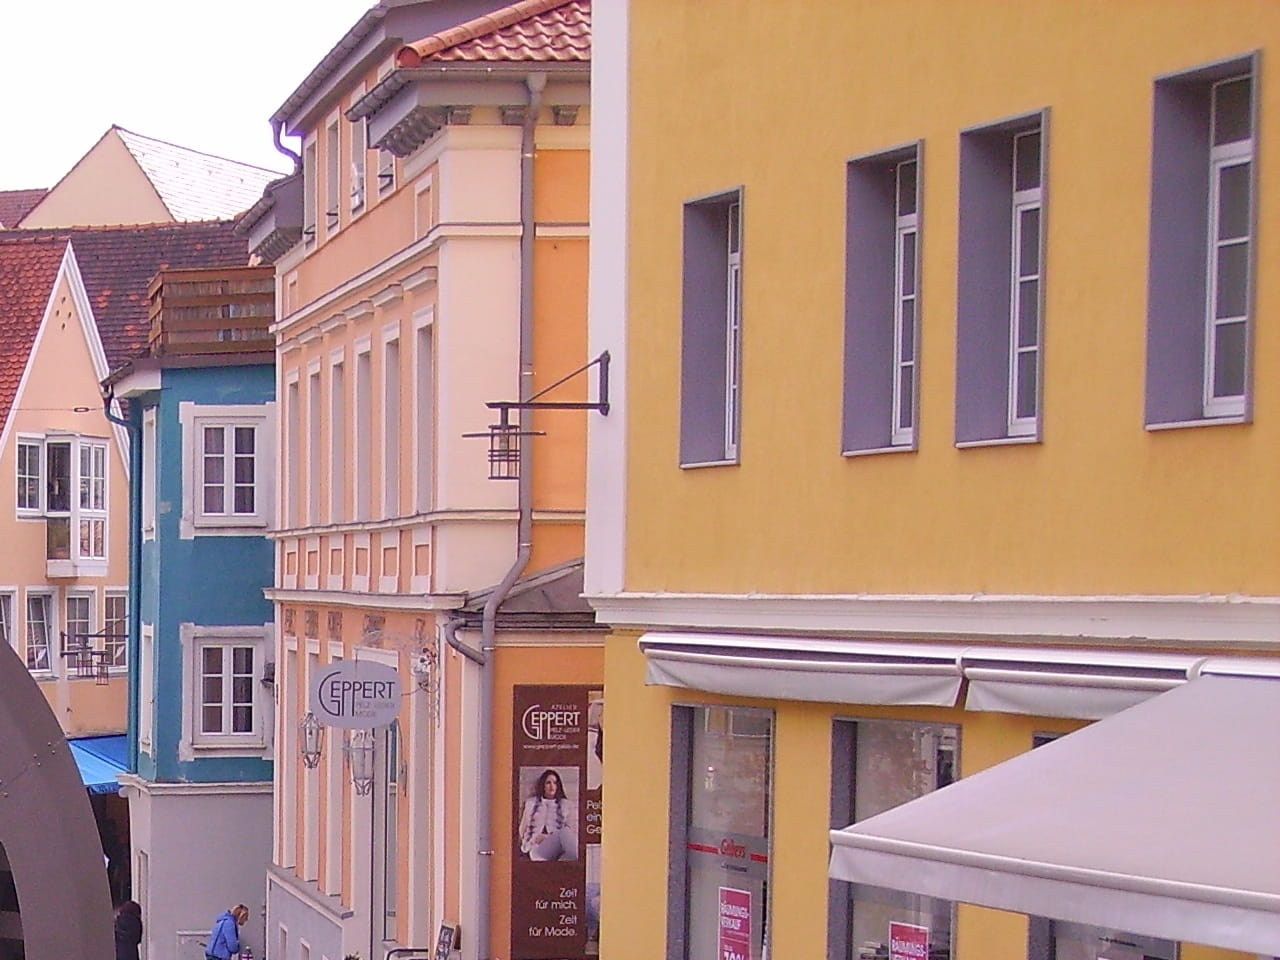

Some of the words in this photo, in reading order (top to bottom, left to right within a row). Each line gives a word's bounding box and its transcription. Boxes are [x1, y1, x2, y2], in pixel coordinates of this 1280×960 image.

[318, 671, 396, 718] GEPPERT
[522, 704, 581, 740] GEPPERT
[559, 888, 578, 898] Zeit
[535, 899, 549, 909] für
[559, 914, 578, 925] Zeit
[528, 926, 543, 936] für
[544, 926, 578, 936] Mode.
